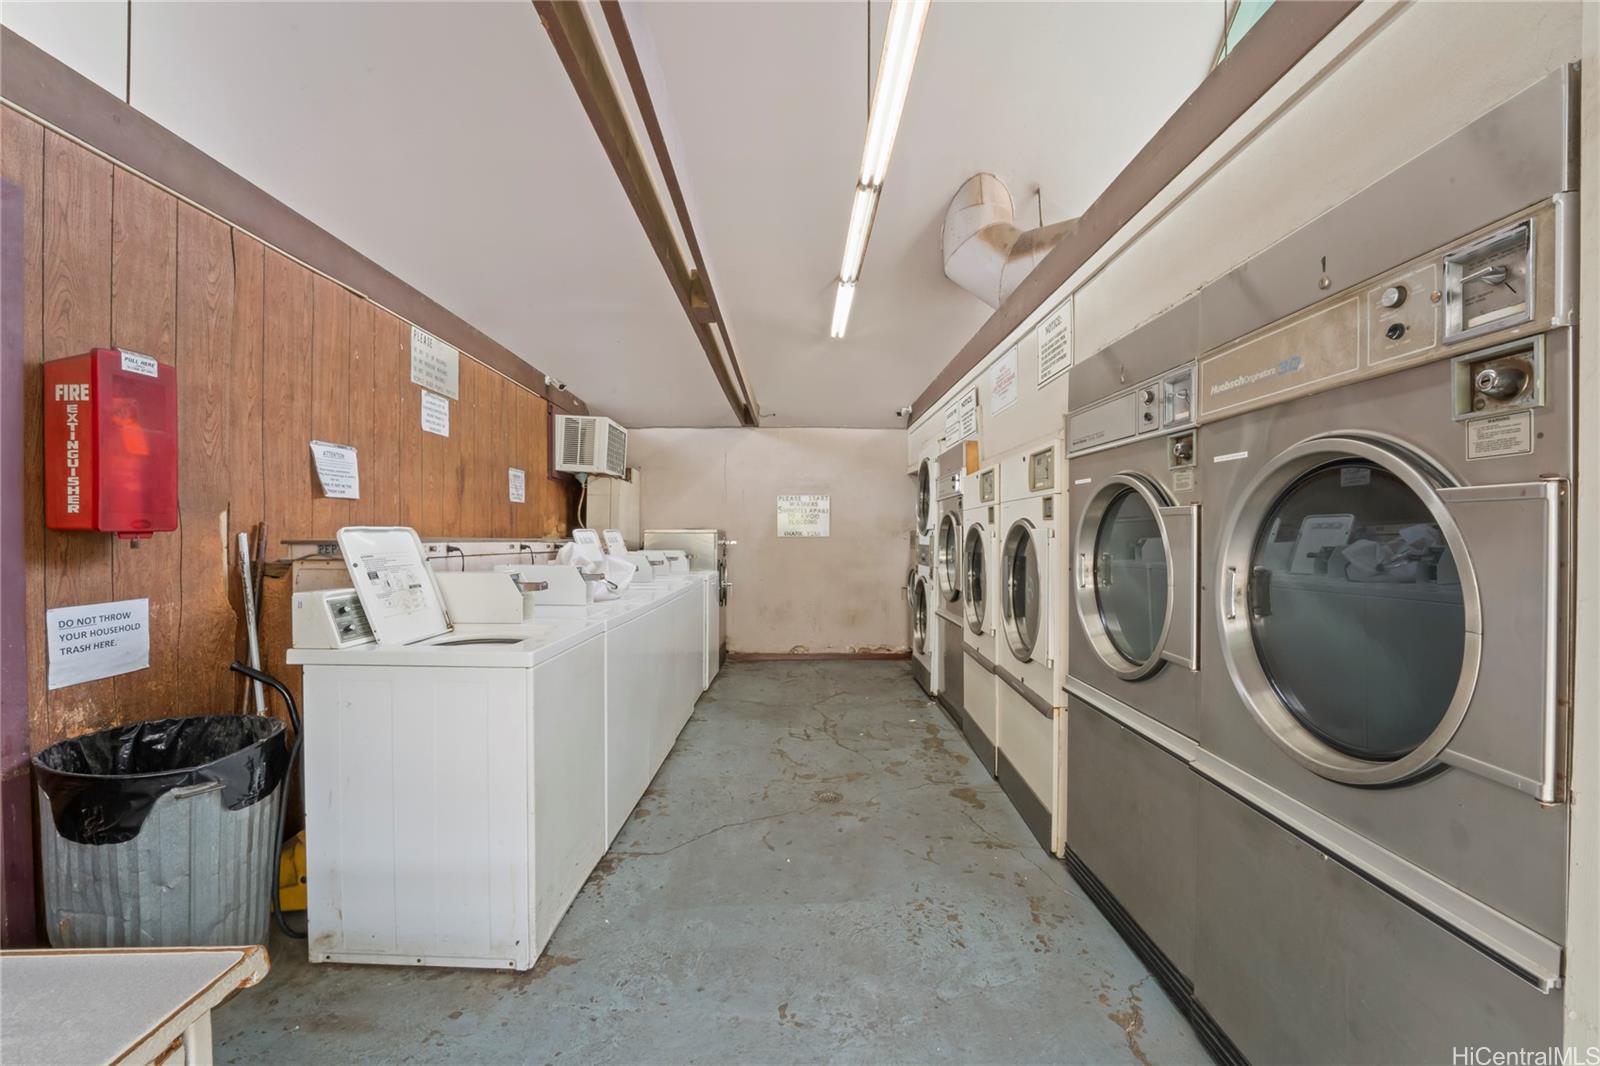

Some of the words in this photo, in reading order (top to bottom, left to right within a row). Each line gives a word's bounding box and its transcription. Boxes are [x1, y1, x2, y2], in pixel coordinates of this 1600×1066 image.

[413, 328, 433, 349] PLEASE
[55, 383, 90, 402] FIRE
[66, 404, 80, 513] EXTINGUISHER
[58, 619, 74, 629] DO
[76, 616, 97, 626] NOT
[99, 612, 132, 623] THROW
[59, 631, 88, 642] YOUR
[89, 623, 141, 638] HOUSEHOLD
[60, 643, 92, 656] TRASH
[93, 639, 118, 650] HERE.
